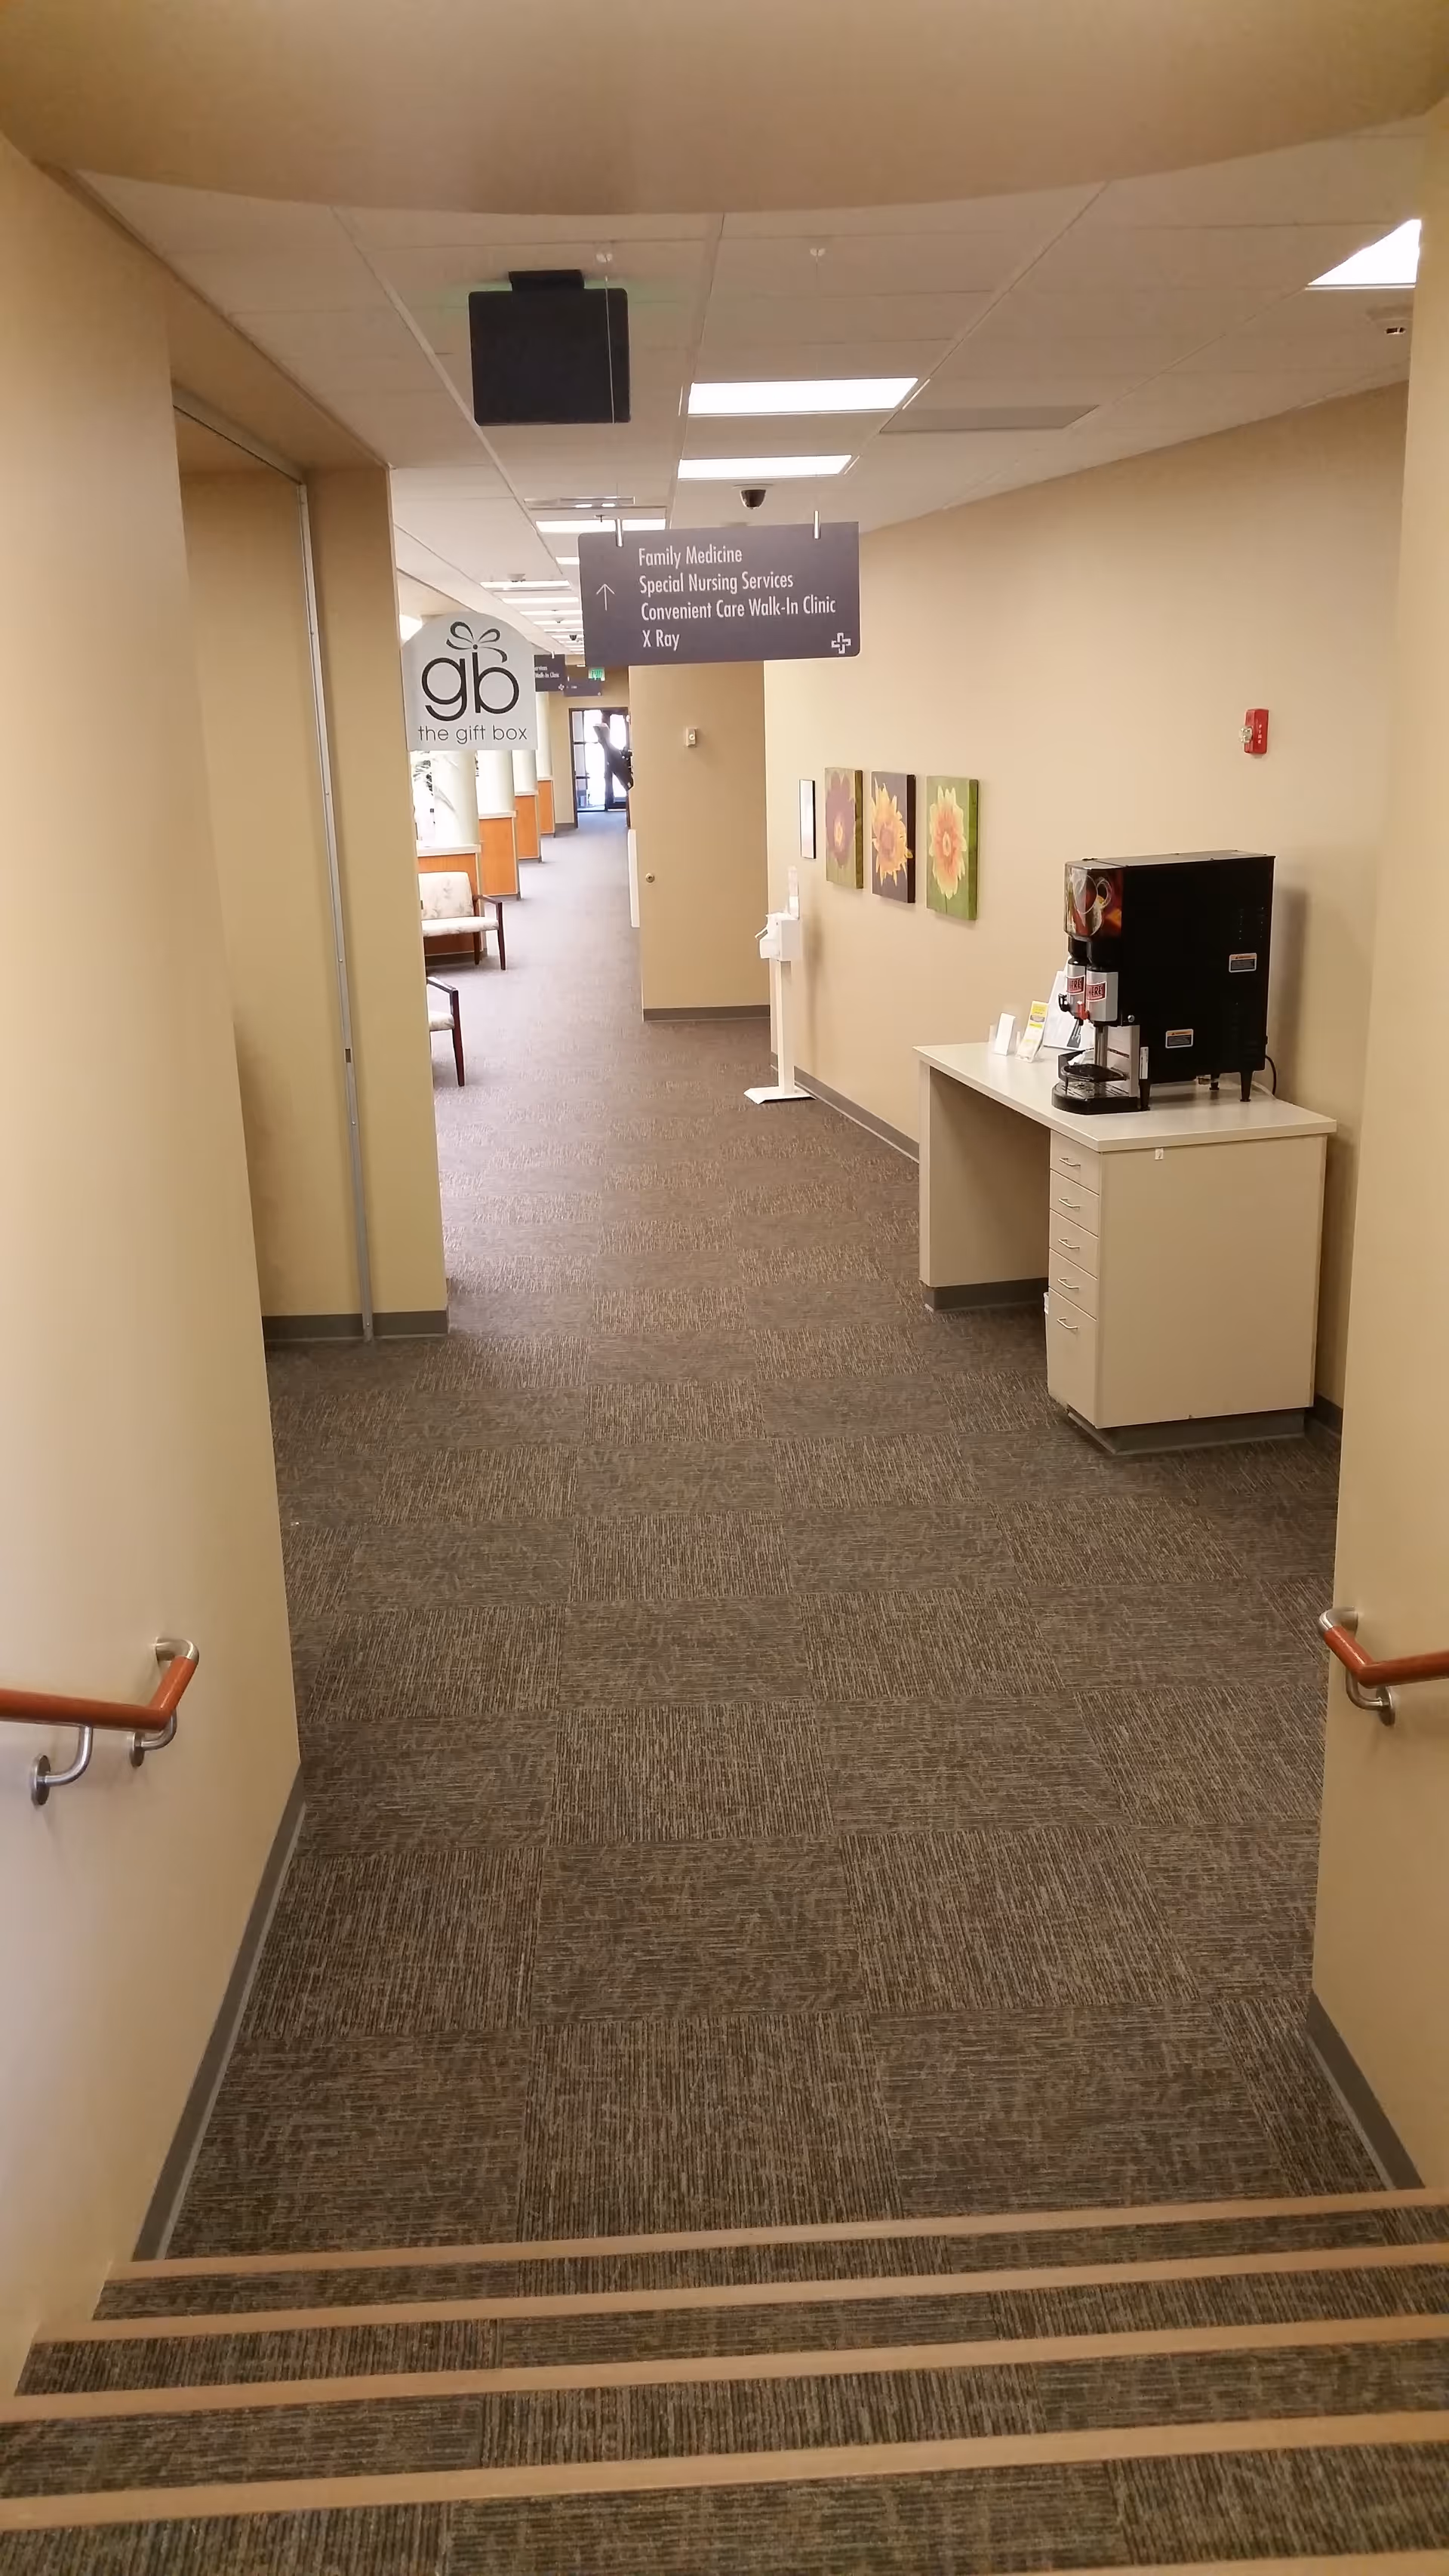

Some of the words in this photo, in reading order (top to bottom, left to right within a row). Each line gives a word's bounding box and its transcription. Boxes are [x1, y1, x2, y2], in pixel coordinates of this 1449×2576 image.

[638, 545, 681, 569] Family
[686, 543, 743, 565] Medicine
[639, 572, 684, 597] Special
[688, 573, 737, 595] Nursing
[742, 571, 794, 590] Services
[641, 602, 712, 621] Convenient
[716, 599, 745, 618] Care
[749, 596, 798, 616] Walk-In
[803, 595, 836, 614] Clinic
[642, 629, 651, 648] X
[656, 629, 680, 651] Ray
[421, 651, 520, 722] gb
[417, 725, 449, 741] the
[456, 725, 486, 745] gift
[492, 725, 528, 740] box
